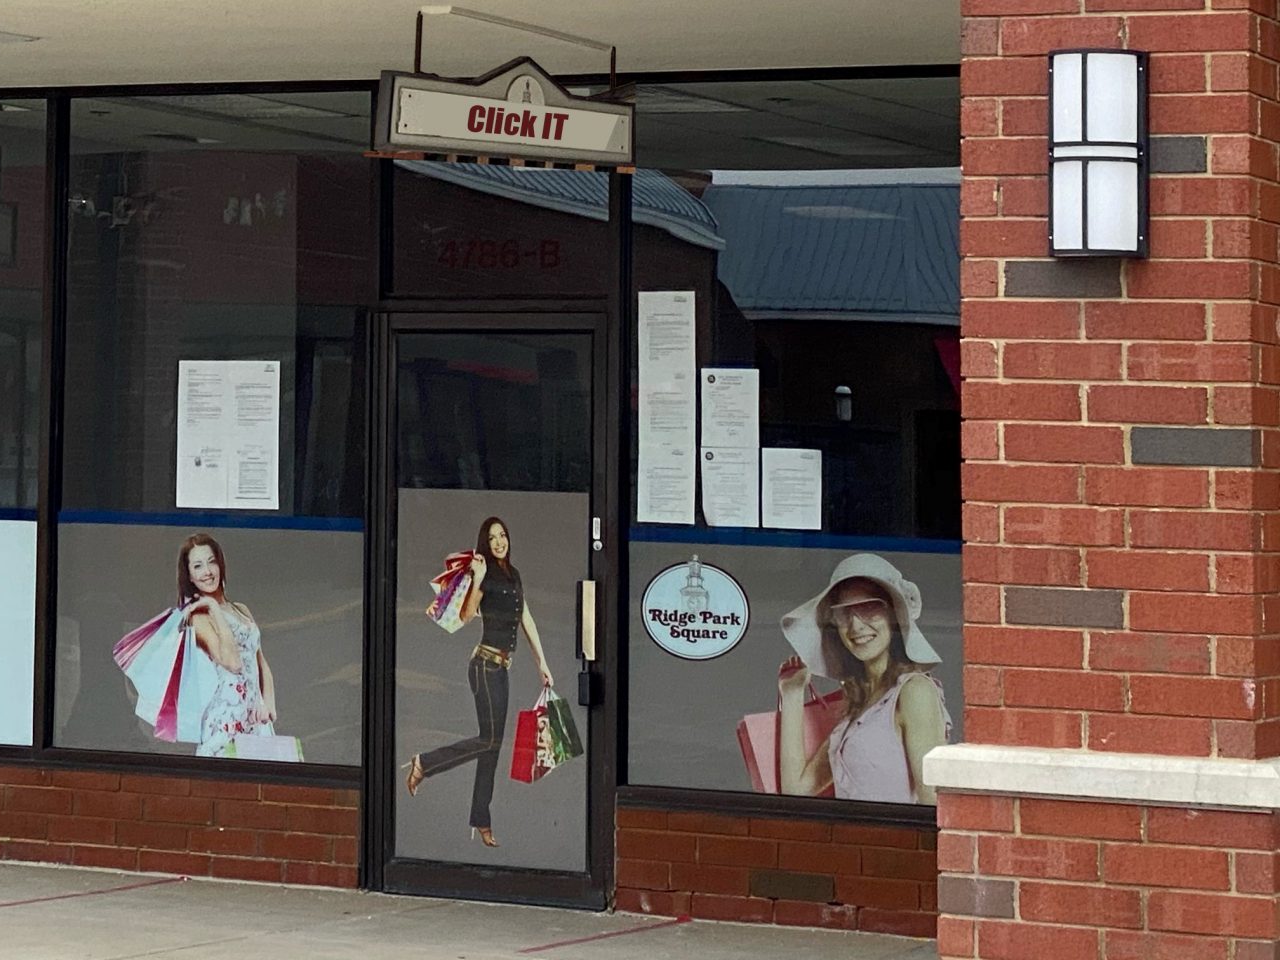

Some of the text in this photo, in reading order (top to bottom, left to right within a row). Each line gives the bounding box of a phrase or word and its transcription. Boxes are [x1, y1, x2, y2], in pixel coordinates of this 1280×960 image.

[467, 104, 569, 141] Click IT
[437, 239, 561, 268] 4786-B
[649, 608, 741, 627] Ridge Park
[669, 625, 728, 643] Square
